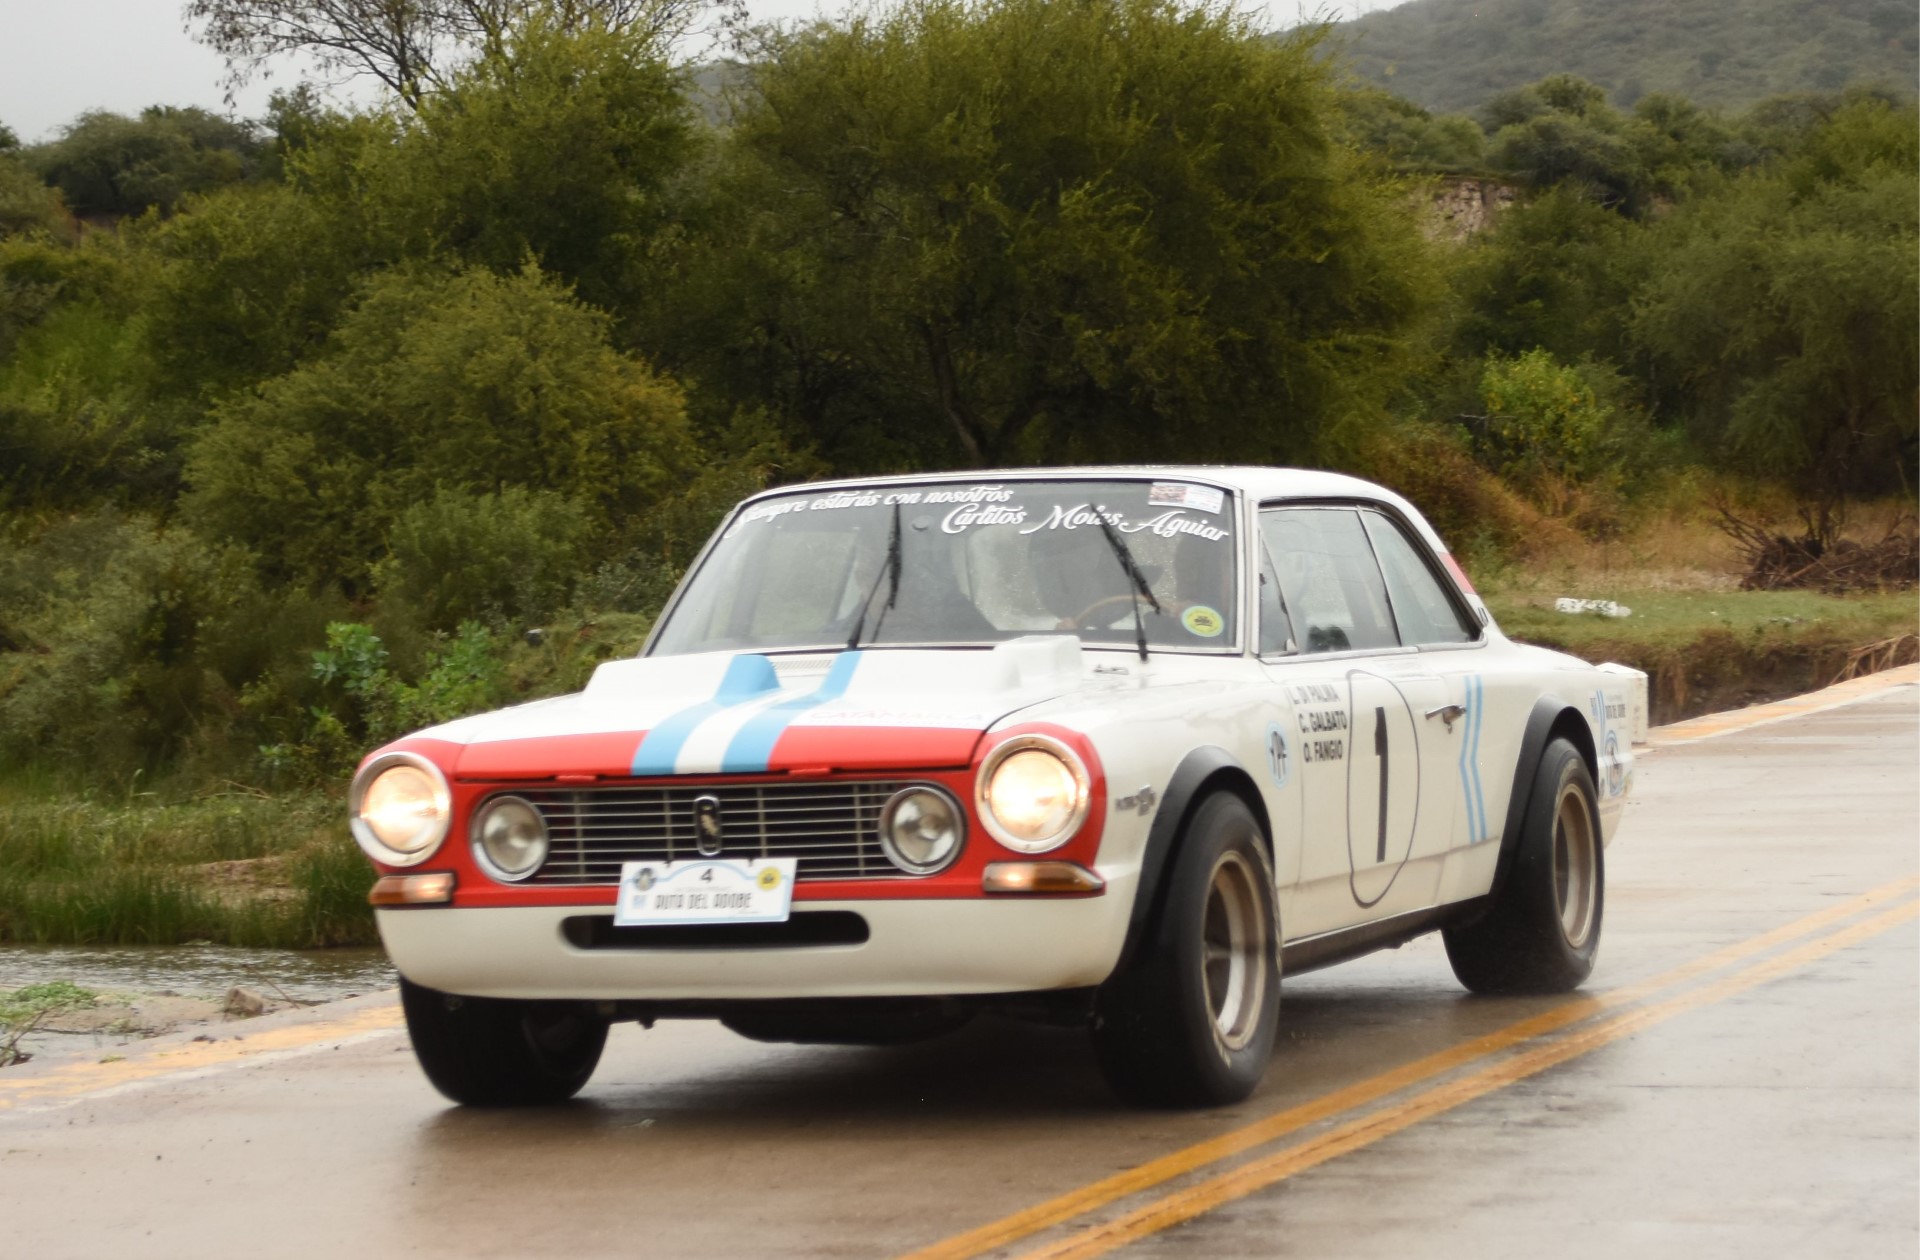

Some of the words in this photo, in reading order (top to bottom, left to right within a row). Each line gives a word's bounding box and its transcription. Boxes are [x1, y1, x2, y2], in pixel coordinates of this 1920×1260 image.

[810, 490, 882, 510] estarás
[883, 492, 922, 505] con
[923, 485, 1014, 503] nosotros
[941, 502, 1028, 534] Carlitos
[1118, 511, 1230, 541] Aguiar
[1307, 684, 1341, 703] PALMA
[1299, 713, 1310, 733] C.
[1309, 710, 1347, 732] GALBATO
[1304, 742, 1313, 763] O.
[1314, 739, 1343, 762] FANGIO
[1375, 706, 1389, 863] 1
[700, 868, 713, 882] 4
[688, 894, 709, 909] DEL
